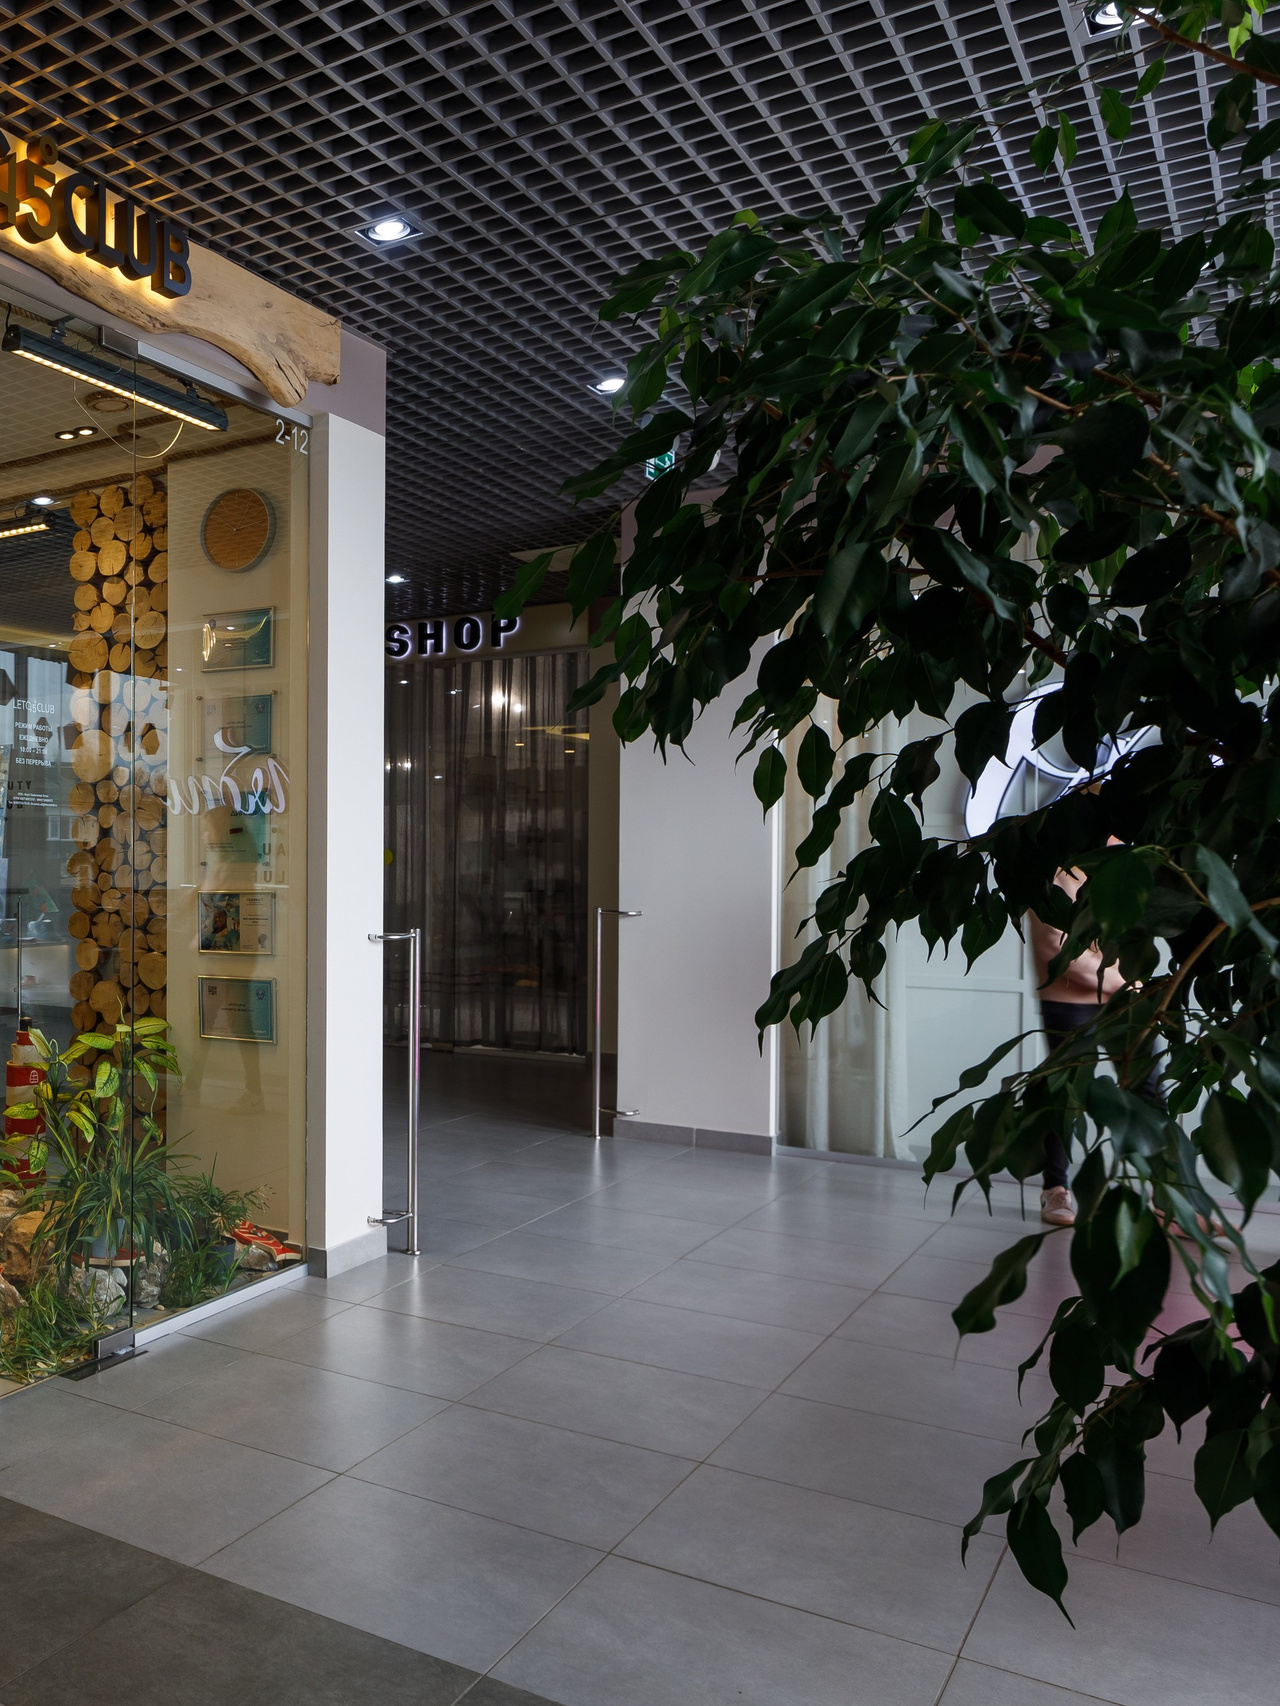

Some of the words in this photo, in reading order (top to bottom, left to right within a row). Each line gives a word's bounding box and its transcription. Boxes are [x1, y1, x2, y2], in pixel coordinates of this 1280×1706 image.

[276, 419, 308, 455] 2-12
[385, 614, 521, 659] SHOP
[26, 758, 51, 767] ПЕРЕРЫВА
